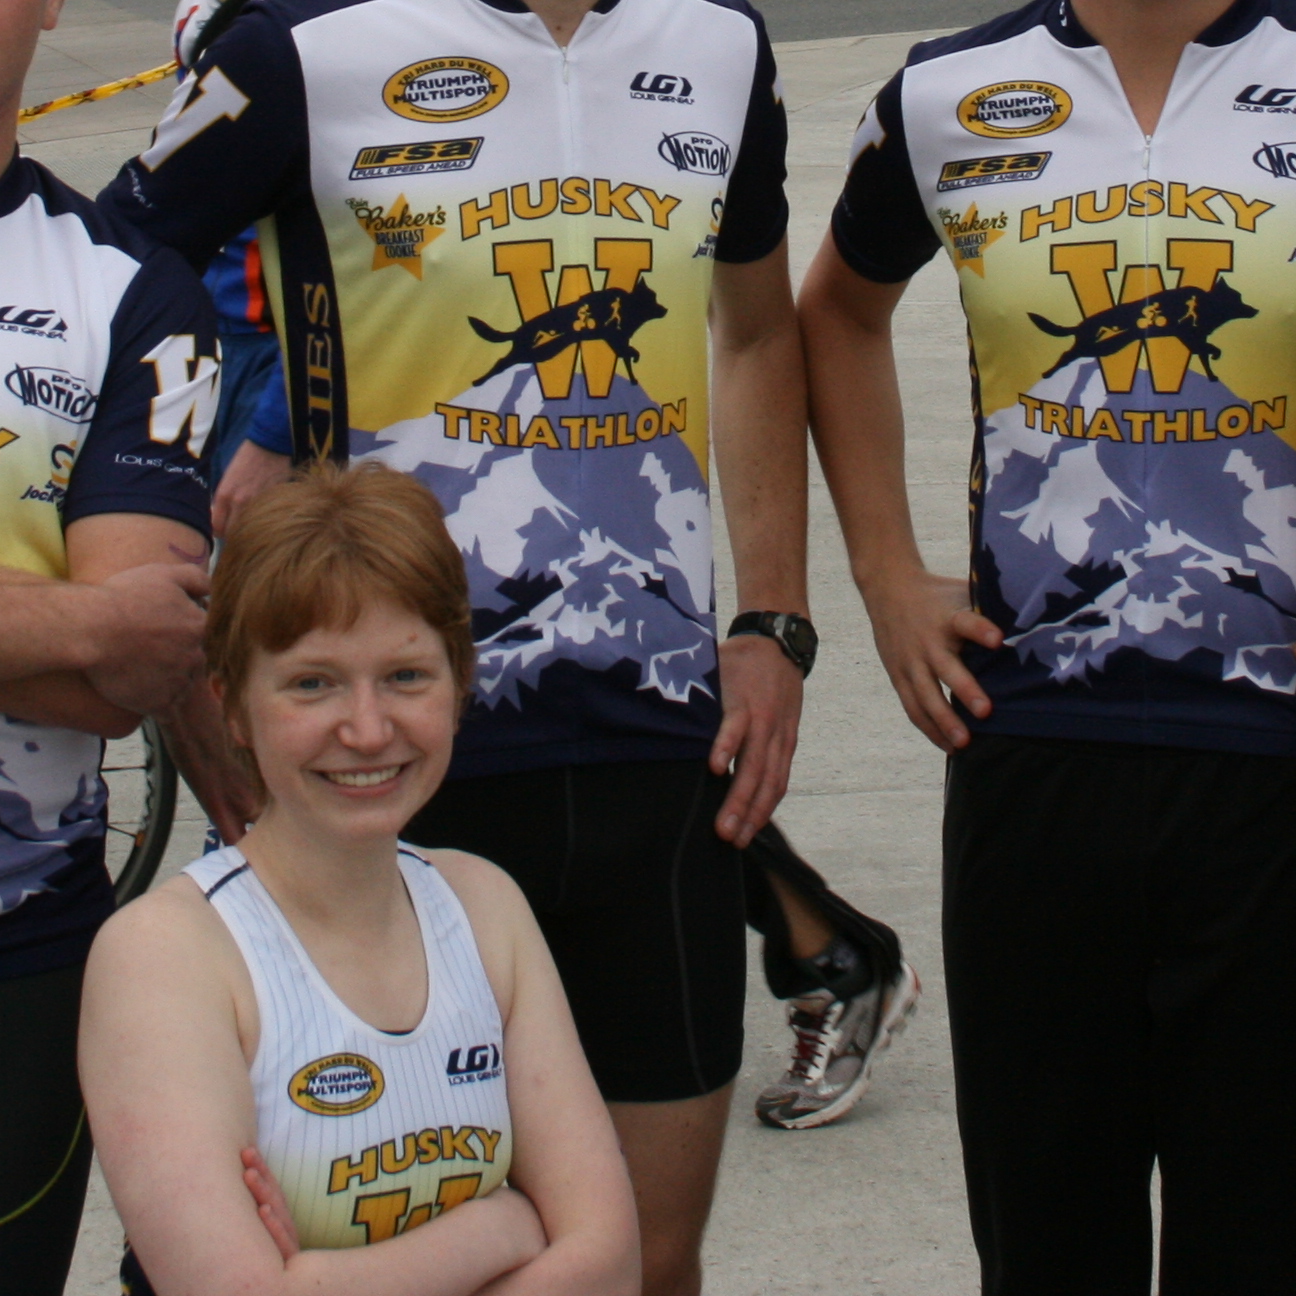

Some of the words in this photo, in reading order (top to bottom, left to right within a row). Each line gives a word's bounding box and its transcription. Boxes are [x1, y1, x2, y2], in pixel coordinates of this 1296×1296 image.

[417, 60, 446, 72] HARD
[449, 60, 464, 68] DU
[468, 61, 493, 78] WELL
[405, 74, 484, 91] TRIUMPH
[989, 83, 1017, 94] HARD
[1036, 84, 1058, 98] WELL
[393, 84, 499, 104] MULTISPORT
[630, 92, 657, 101] LOUIS
[979, 95, 1049, 111] TRIUMPH
[967, 104, 1063, 123] MULTISPORT
[1233, 104, 1264, 113] LOUIS
[691, 136, 713, 145] pro
[662, 132, 730, 178] MOTION
[356, 169, 384, 179] FULL
[387, 163, 425, 175] SPEED
[427, 160, 467, 171] AHEAD
[997, 172, 1034, 181] AHEAD
[355, 203, 446, 231] Baker's
[459, 176, 682, 241] HUSKY
[1019, 180, 1276, 243] HUSKY
[942, 210, 1008, 235] Baker's
[375, 229, 424, 245] BREAKFAST
[492, 238, 653, 400] W
[1050, 238, 1234, 394] W
[435, 398, 687, 450] TRIATHLON
[1018, 393, 1288, 444] TRIATHLON
[114, 454, 164, 468] LOUIS
[311, 1071, 368, 1084] TRIUMPH
[297, 1080, 378, 1096] MULTISPORT
[327, 1125, 502, 1195] HUSKY
